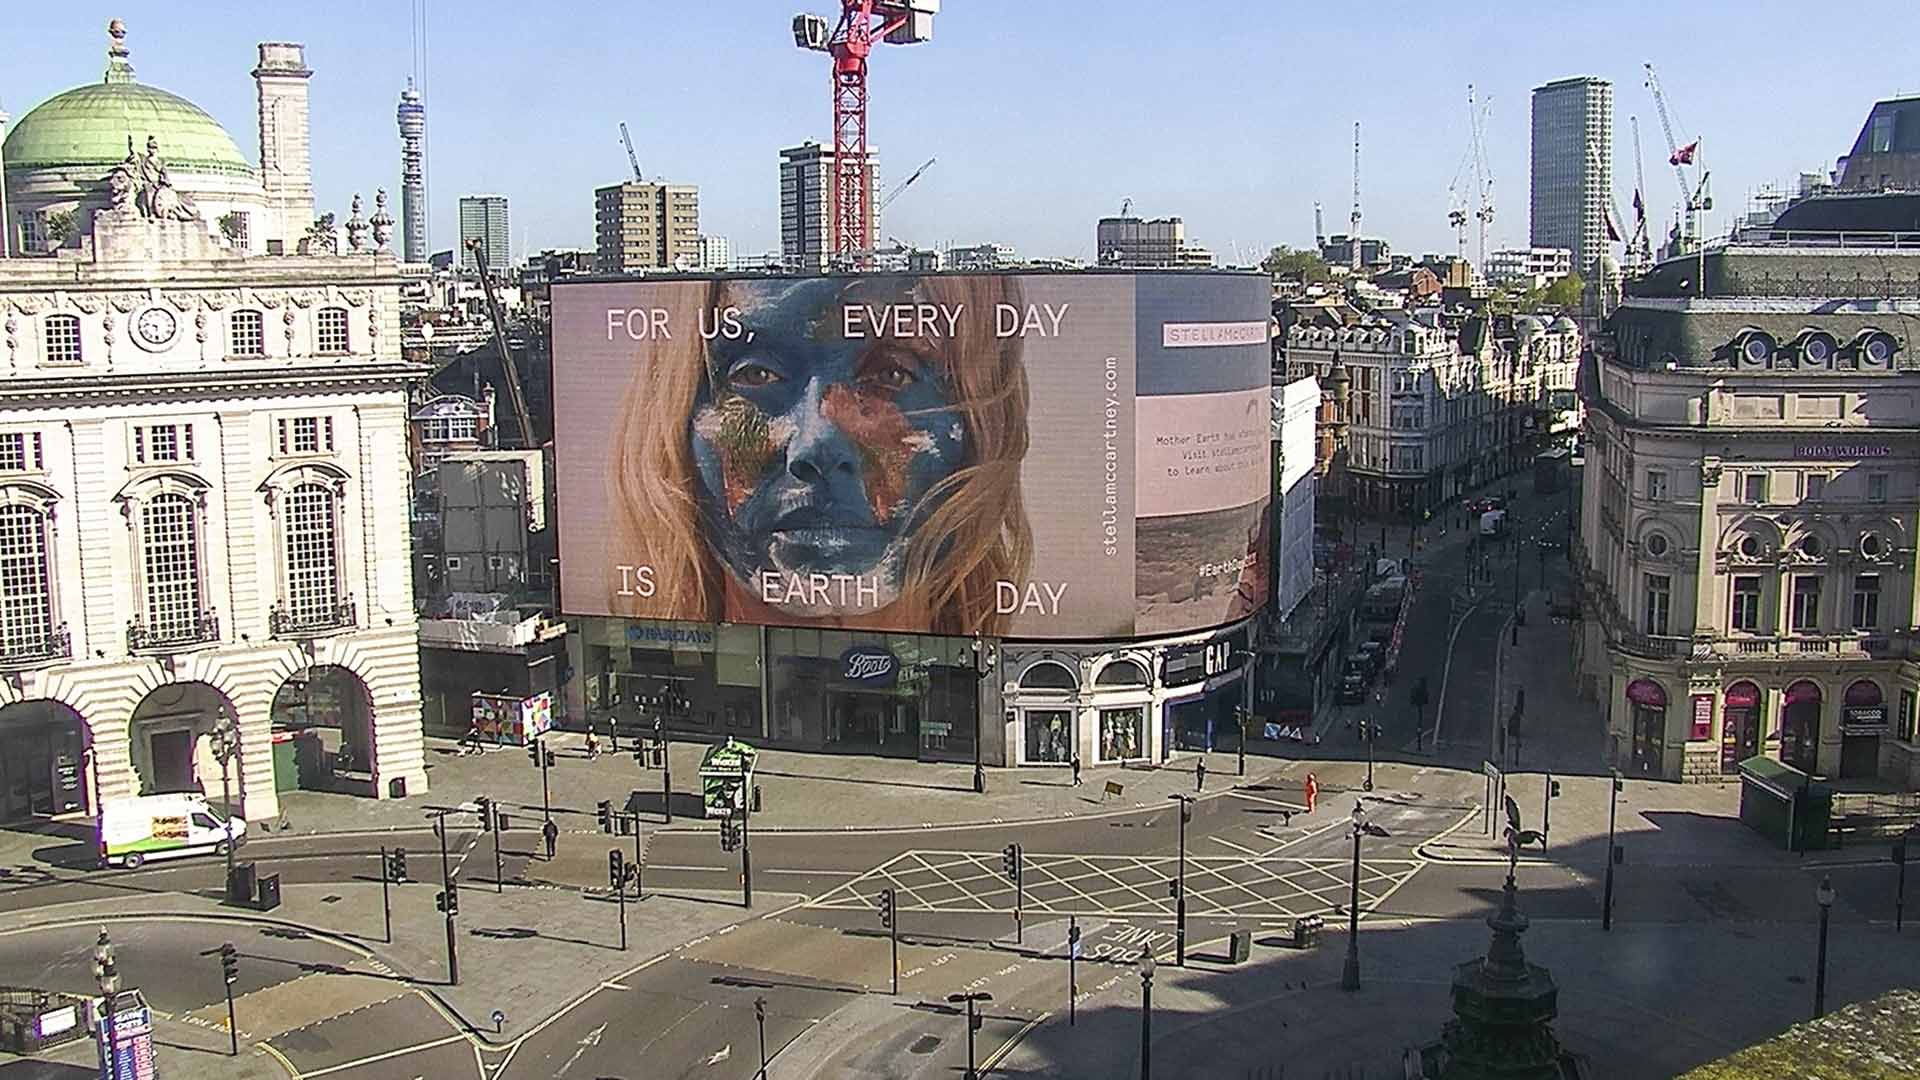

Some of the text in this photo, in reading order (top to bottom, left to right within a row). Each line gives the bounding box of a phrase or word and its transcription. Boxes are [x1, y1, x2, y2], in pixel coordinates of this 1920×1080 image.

[607, 302, 1069, 343] FOR US, EVERY DAY
[1103, 356, 1120, 557] stellamccartney.com
[615, 565, 1068, 616] IS EARTH DAY
[844, 652, 892, 679] Boots
[1205, 641, 1231, 675] GAP
